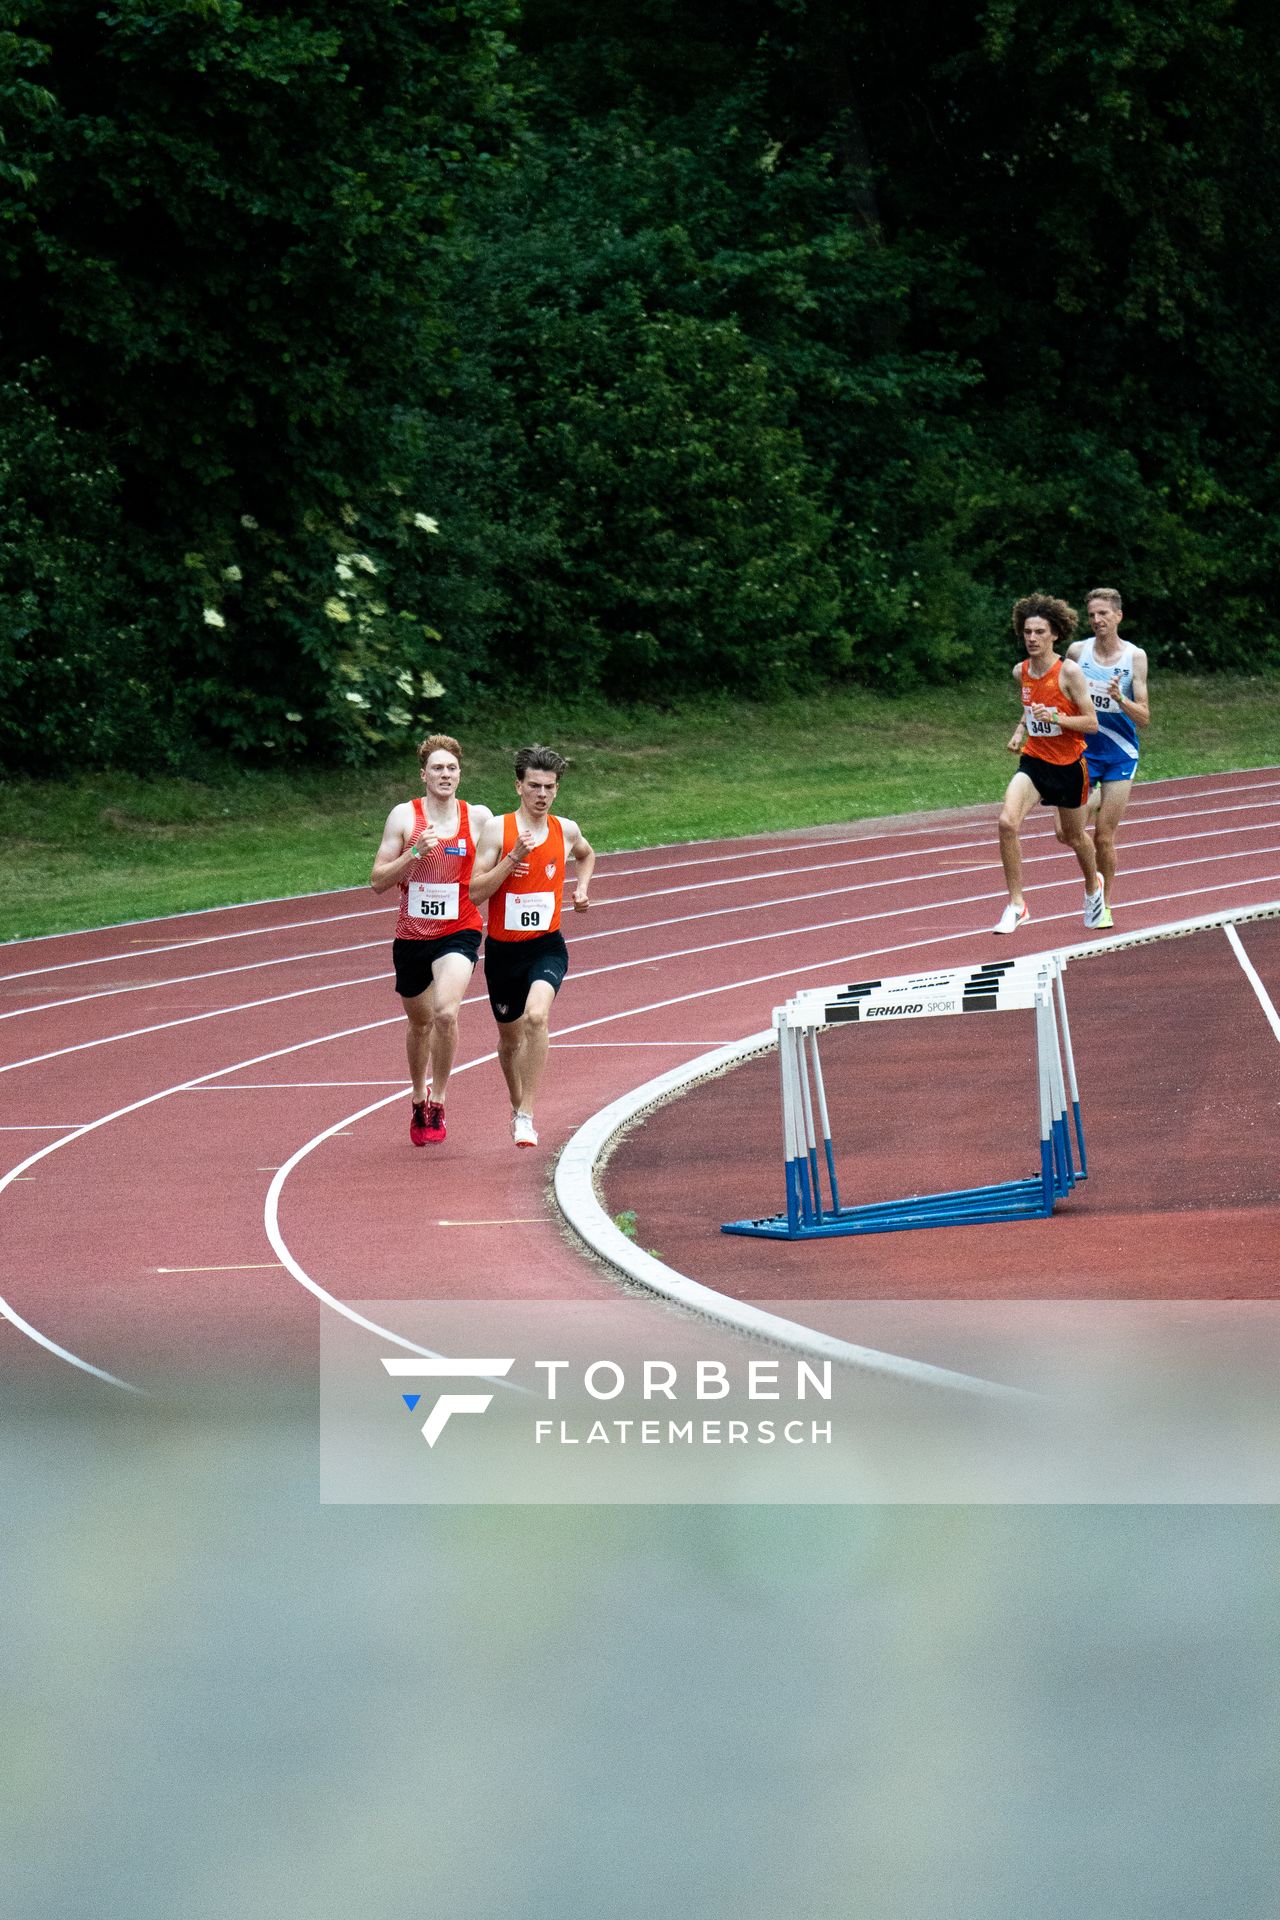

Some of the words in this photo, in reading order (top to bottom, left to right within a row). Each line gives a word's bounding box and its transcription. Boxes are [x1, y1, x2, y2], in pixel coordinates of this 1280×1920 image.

[1031, 720, 1051, 734] 349
[420, 900, 446, 916] 551
[520, 911, 540, 927] 69
[866, 1003, 923, 1017] ERHARD
[927, 1000, 956, 1013] SPORT
